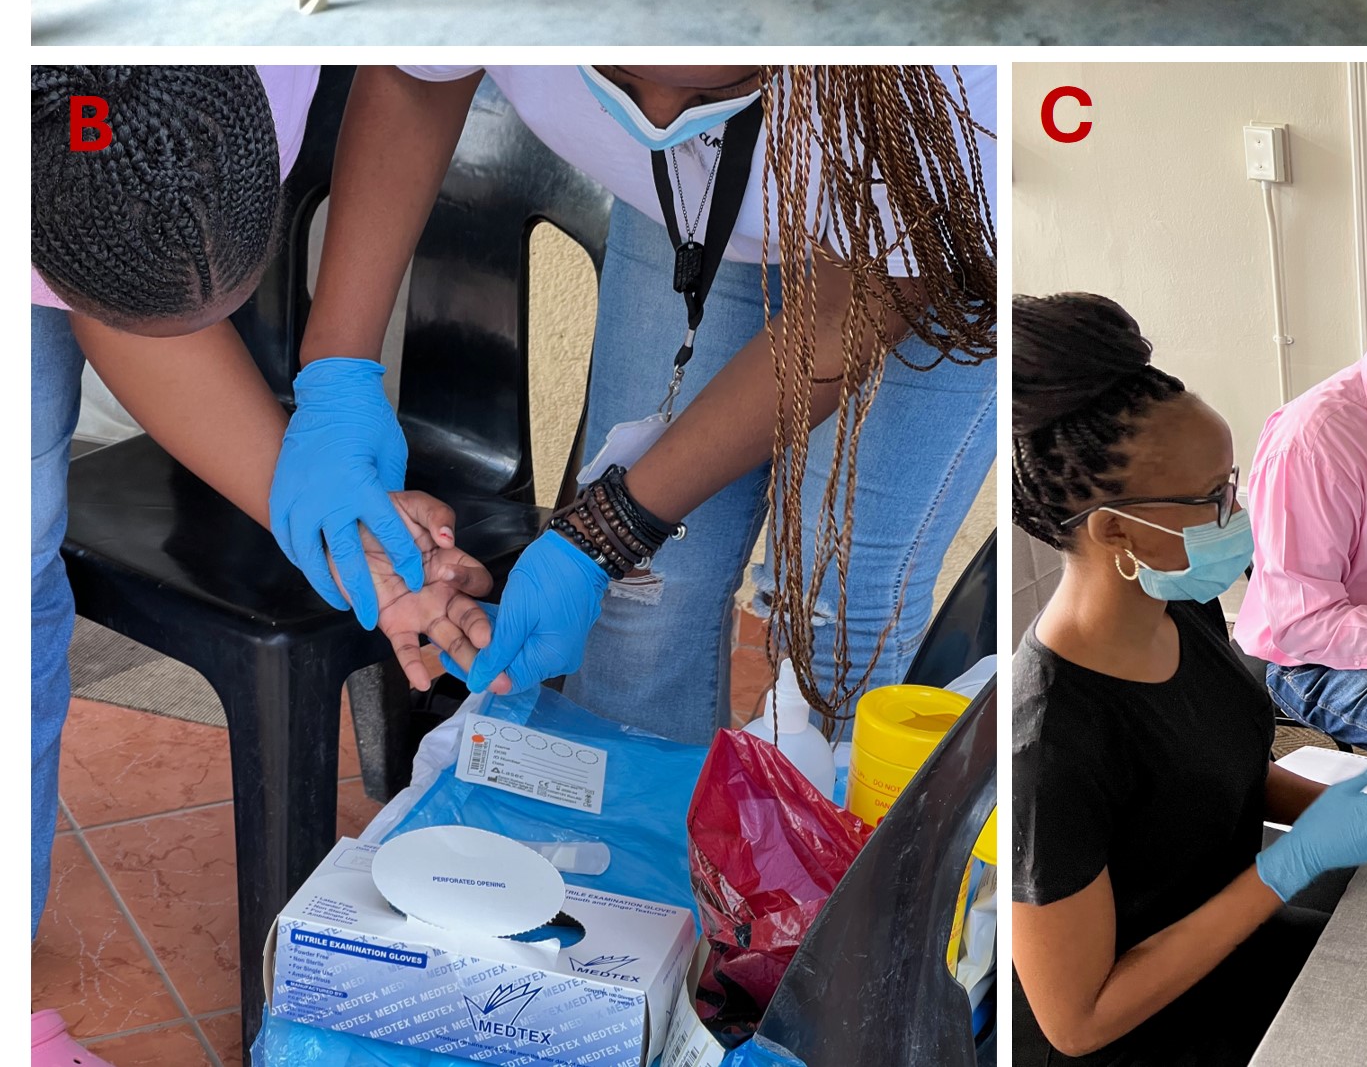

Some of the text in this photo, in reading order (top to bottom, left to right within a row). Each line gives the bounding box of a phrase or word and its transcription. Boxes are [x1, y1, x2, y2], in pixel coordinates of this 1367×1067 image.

[873, 779, 901, 793] DO NOT
[432, 875, 506, 889] PERFORATED OPENING
[342, 906, 358, 914] Free
[588, 893, 643, 908] EXAMINATION
[644, 905, 677, 915] GLOVES
[592, 899, 607, 907] and
[608, 902, 634, 912] Finger
[635, 908, 667, 917] Textured
[295, 934, 328, 946] NITRILE
[330, 941, 387, 959] EXAMINATION
[389, 952, 423, 965] GLOVES
[316, 952, 329, 960] Free
[306, 959, 324, 967] Sterile
[427, 959, 467, 978] MEDTEX
[463, 964, 507, 987] MEDTEX
[576, 967, 641, 983] MEDTEX
[336, 991, 379, 1012] MEDTEX
[420, 982, 460, 1002] MEDTEX
[375, 996, 418, 1019] MEDTEX
[413, 1004, 455, 1025] MEDTEX
[331, 1013, 373, 1031] MEDTEX
[370, 1018, 411, 1039] MEDTEX
[408, 1025, 450, 1045] MEDTEX
[479, 1020, 551, 1046] MEDTEX
[583, 1022, 627, 1044] MEDTEX
[537, 1038, 581, 1059] MEDTEX
[577, 1044, 621, 1065] MEDTEX
